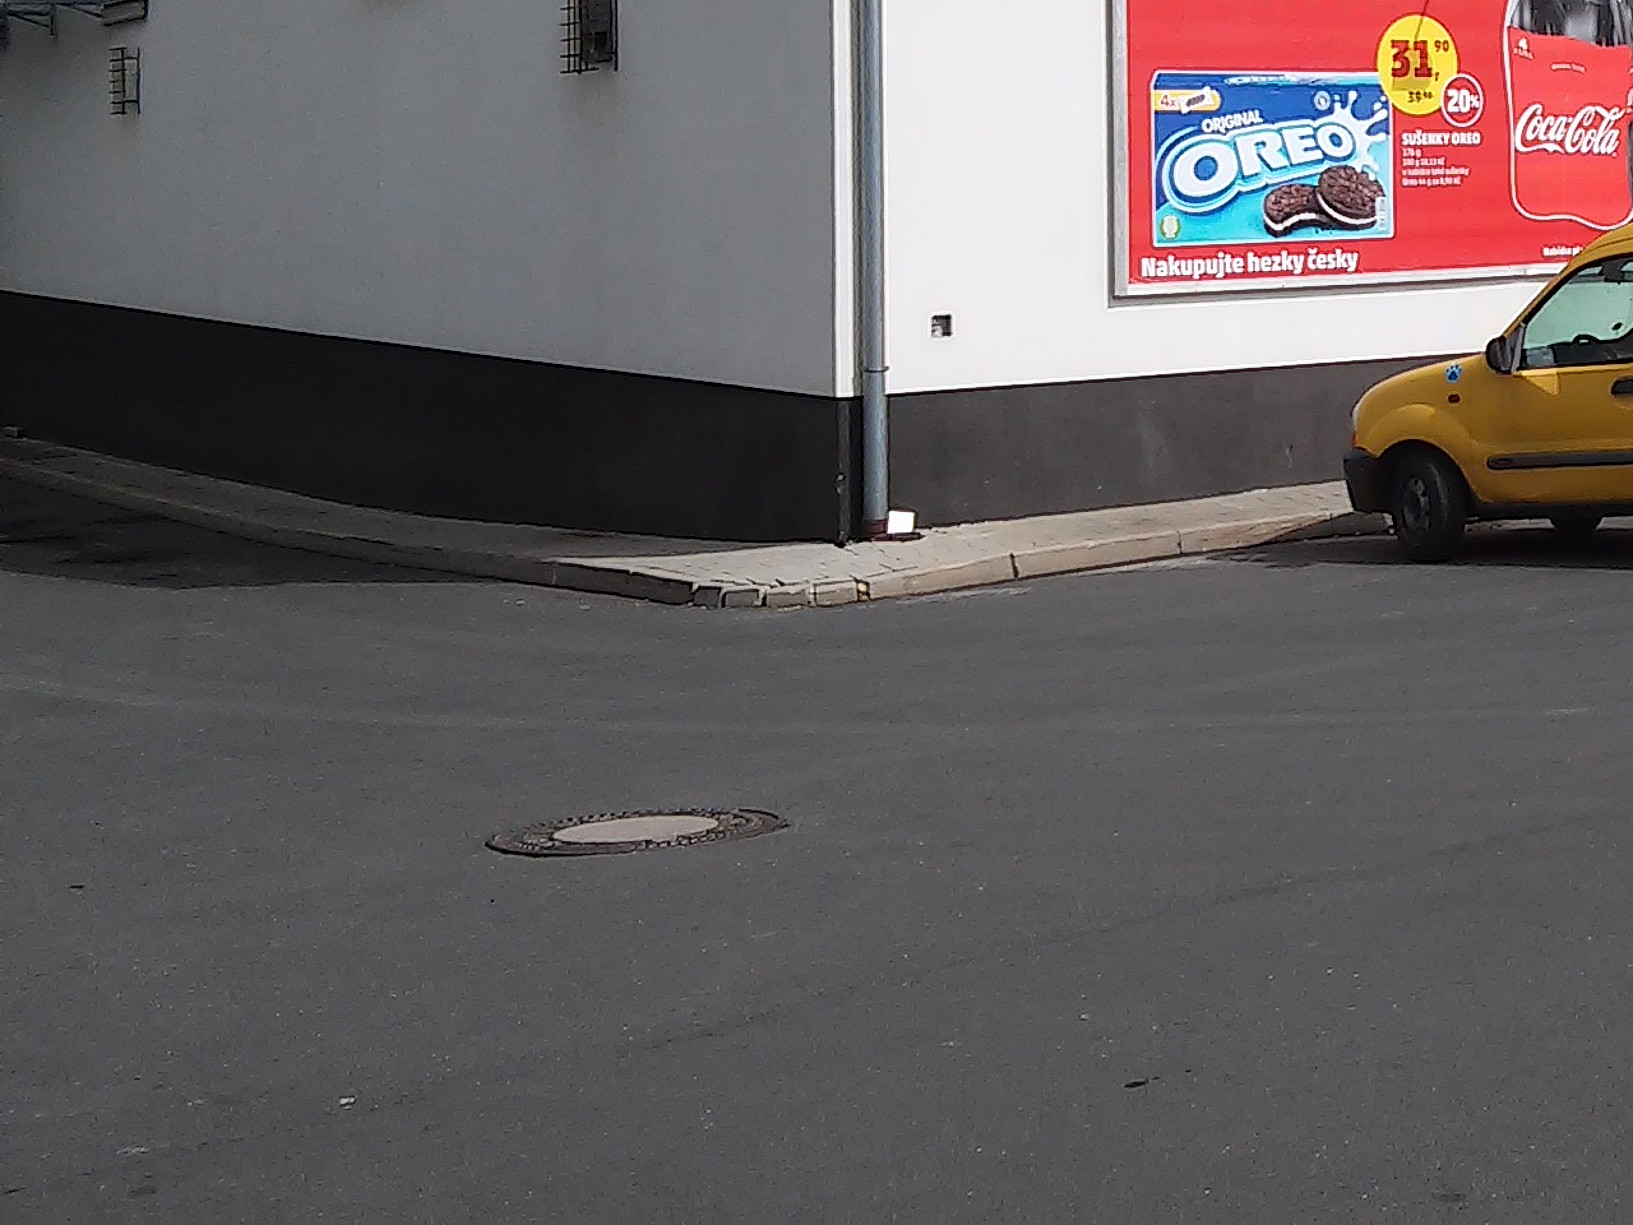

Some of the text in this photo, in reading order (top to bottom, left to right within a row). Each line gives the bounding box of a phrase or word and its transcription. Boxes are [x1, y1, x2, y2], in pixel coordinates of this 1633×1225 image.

[1446, 88, 1481, 114] 20%
[1201, 109, 1264, 133] ORIGINAL
[1515, 103, 1620, 154] Coca-Cola
[1451, 131, 1481, 145] OREO
[1172, 122, 1356, 199] OREO
[1141, 247, 1359, 279] Nakupujte hezky česky
